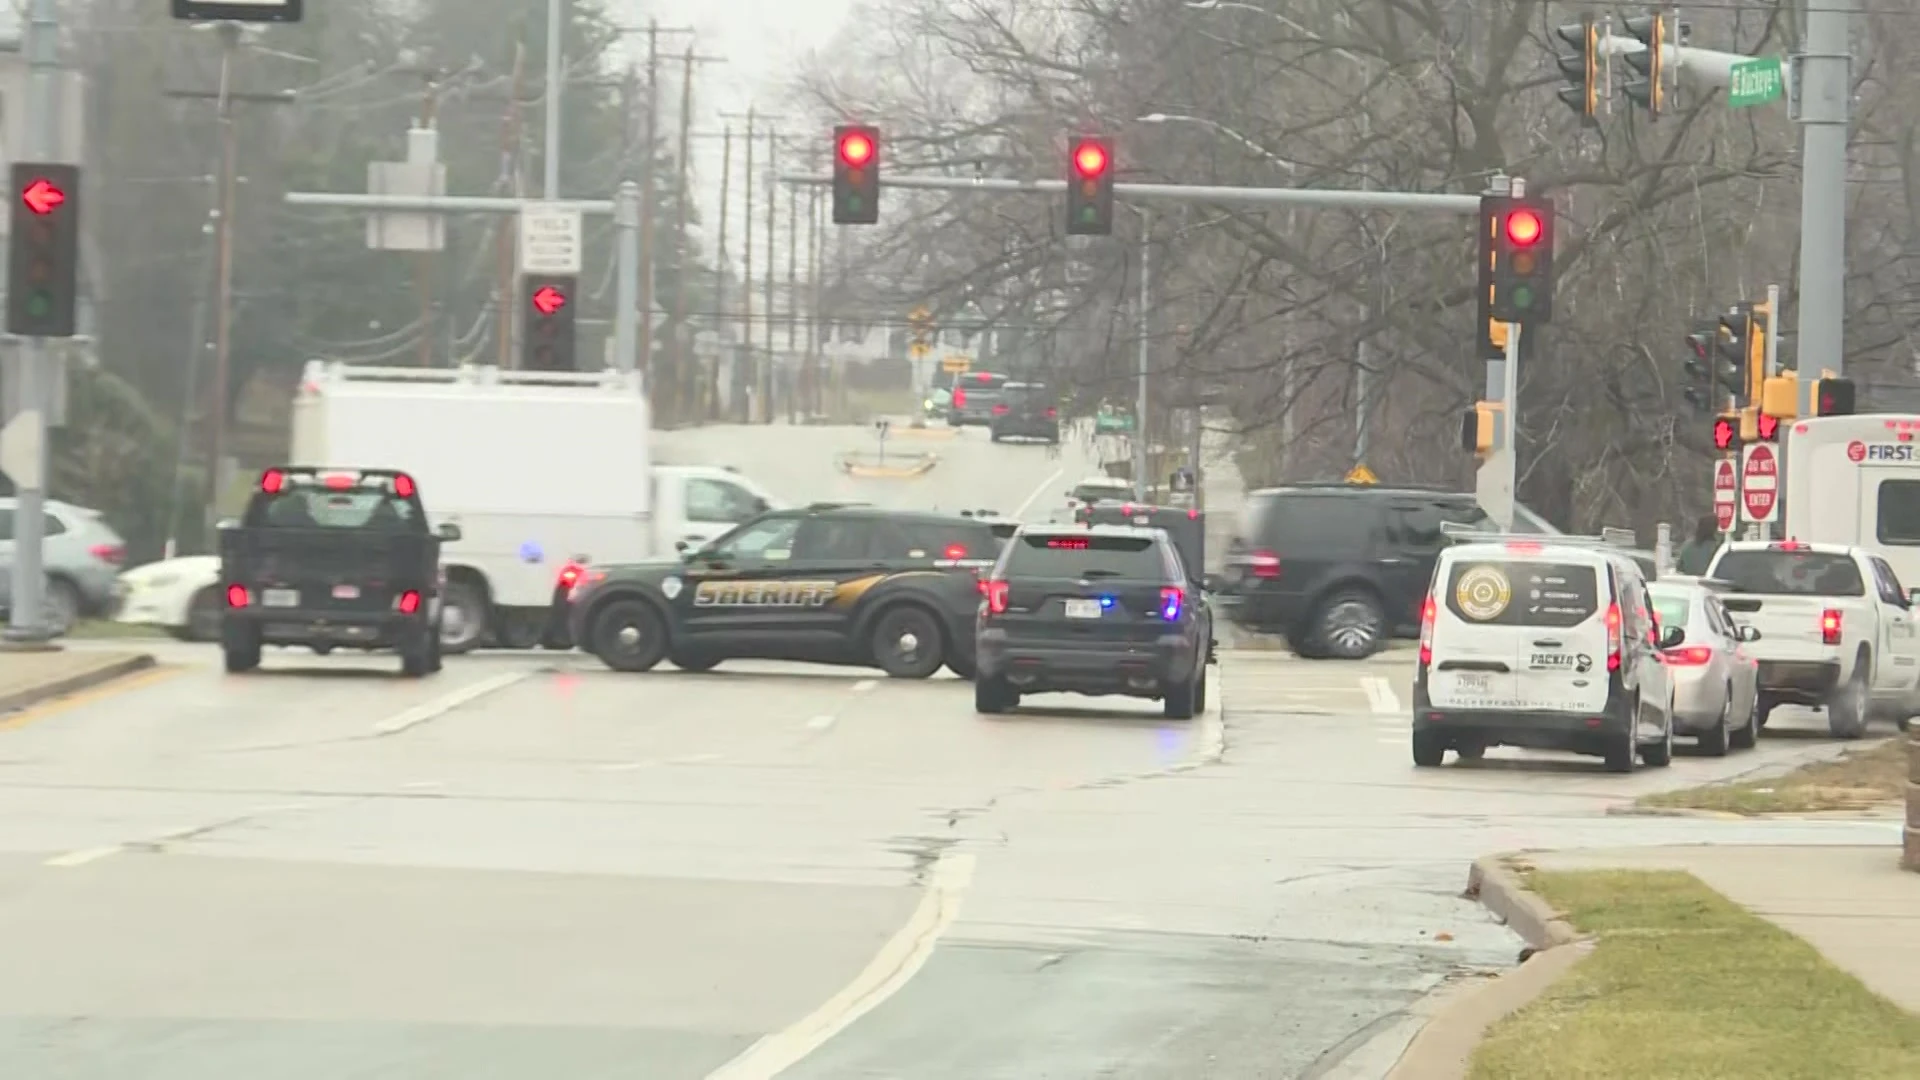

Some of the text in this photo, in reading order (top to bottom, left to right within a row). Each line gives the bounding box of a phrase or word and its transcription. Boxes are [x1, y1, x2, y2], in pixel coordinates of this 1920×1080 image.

[1869, 445, 1913, 460] FIRST
[1748, 459, 1774, 472] DO NOT
[1749, 493, 1771, 506] ENTER
[694, 580, 837, 606] SHERIFF
